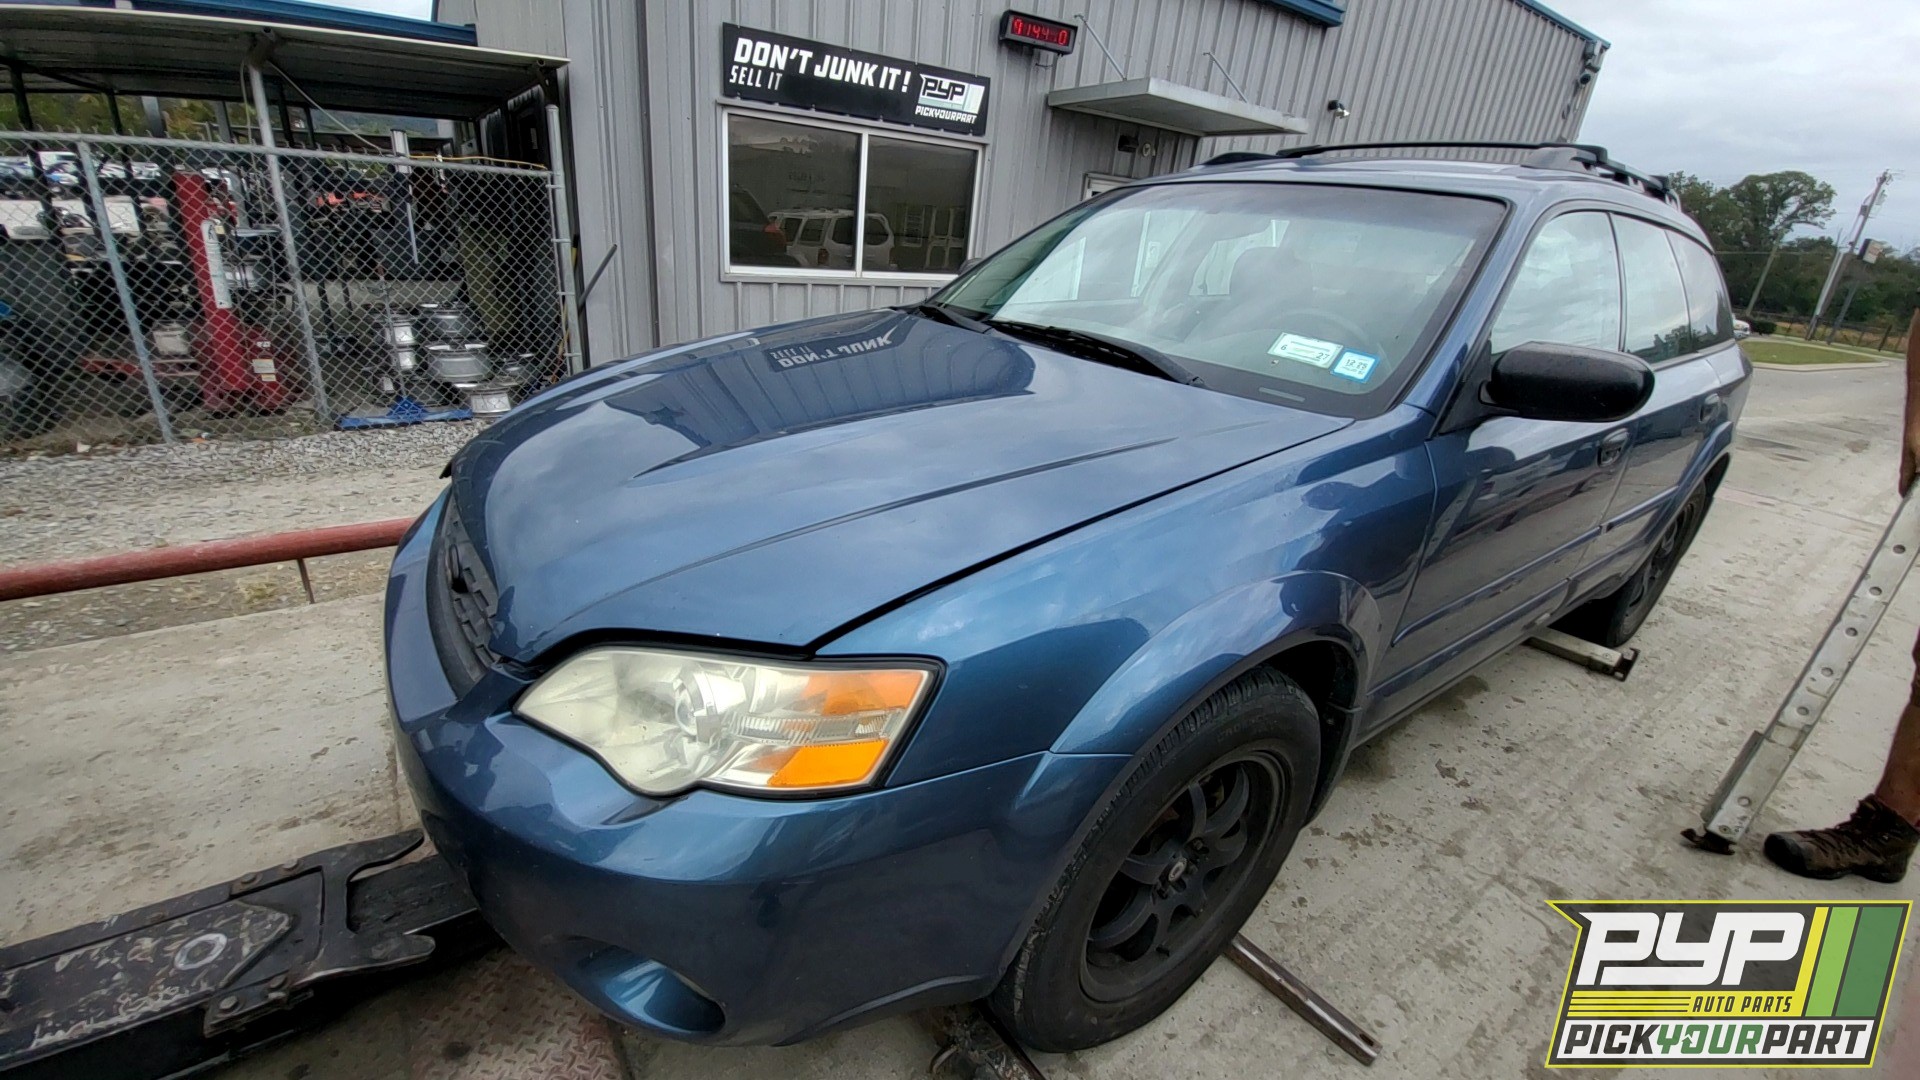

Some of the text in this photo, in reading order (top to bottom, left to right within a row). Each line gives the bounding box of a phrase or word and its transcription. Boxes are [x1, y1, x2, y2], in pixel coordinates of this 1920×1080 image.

[734, 37, 912, 93] DON'T JUNK IT!
[729, 65, 783, 91] SELL IT
[921, 77, 966, 101] PYP
[914, 105, 978, 125] PICKYOURPART
